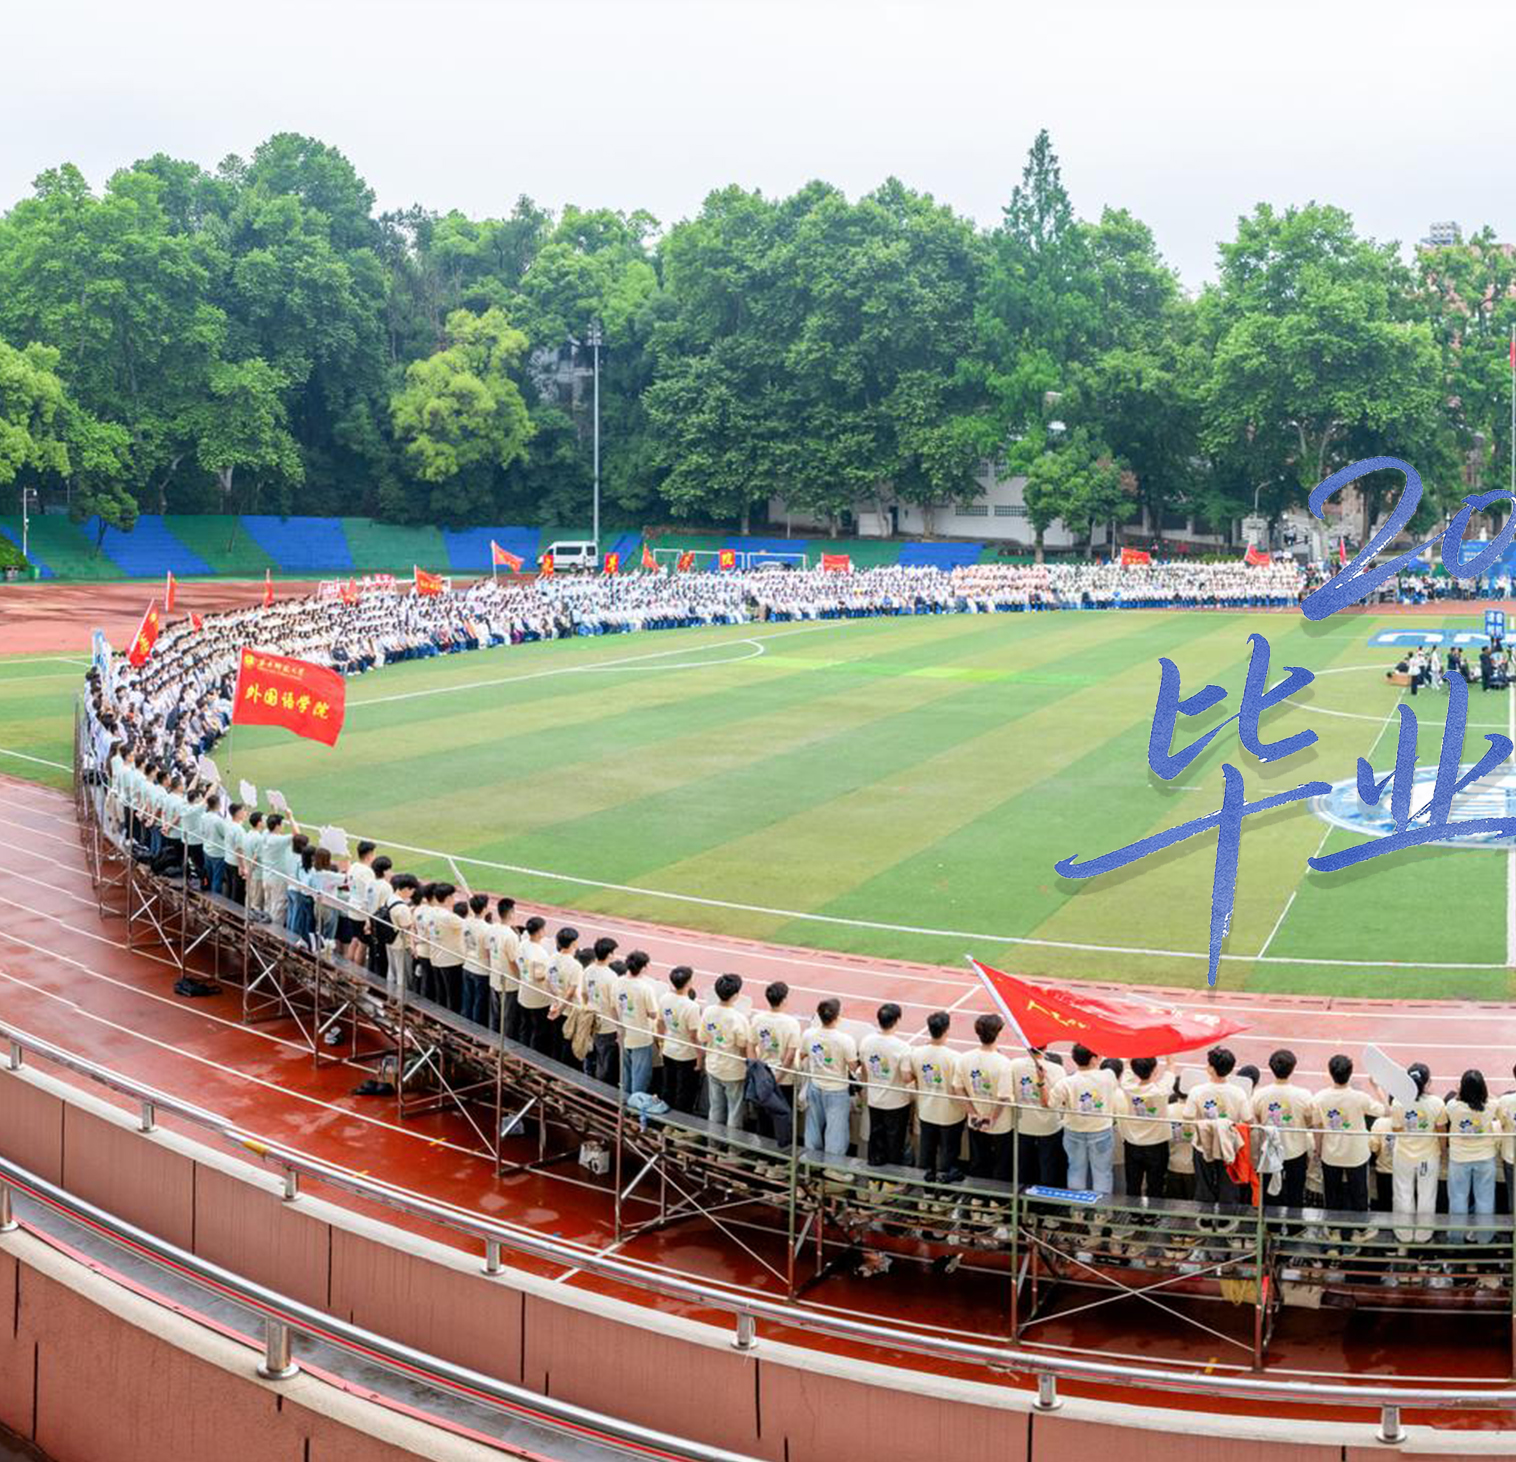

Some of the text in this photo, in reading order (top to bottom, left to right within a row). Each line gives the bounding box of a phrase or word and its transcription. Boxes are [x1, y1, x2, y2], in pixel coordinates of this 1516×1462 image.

[245, 683, 330, 719] 外国语学院
